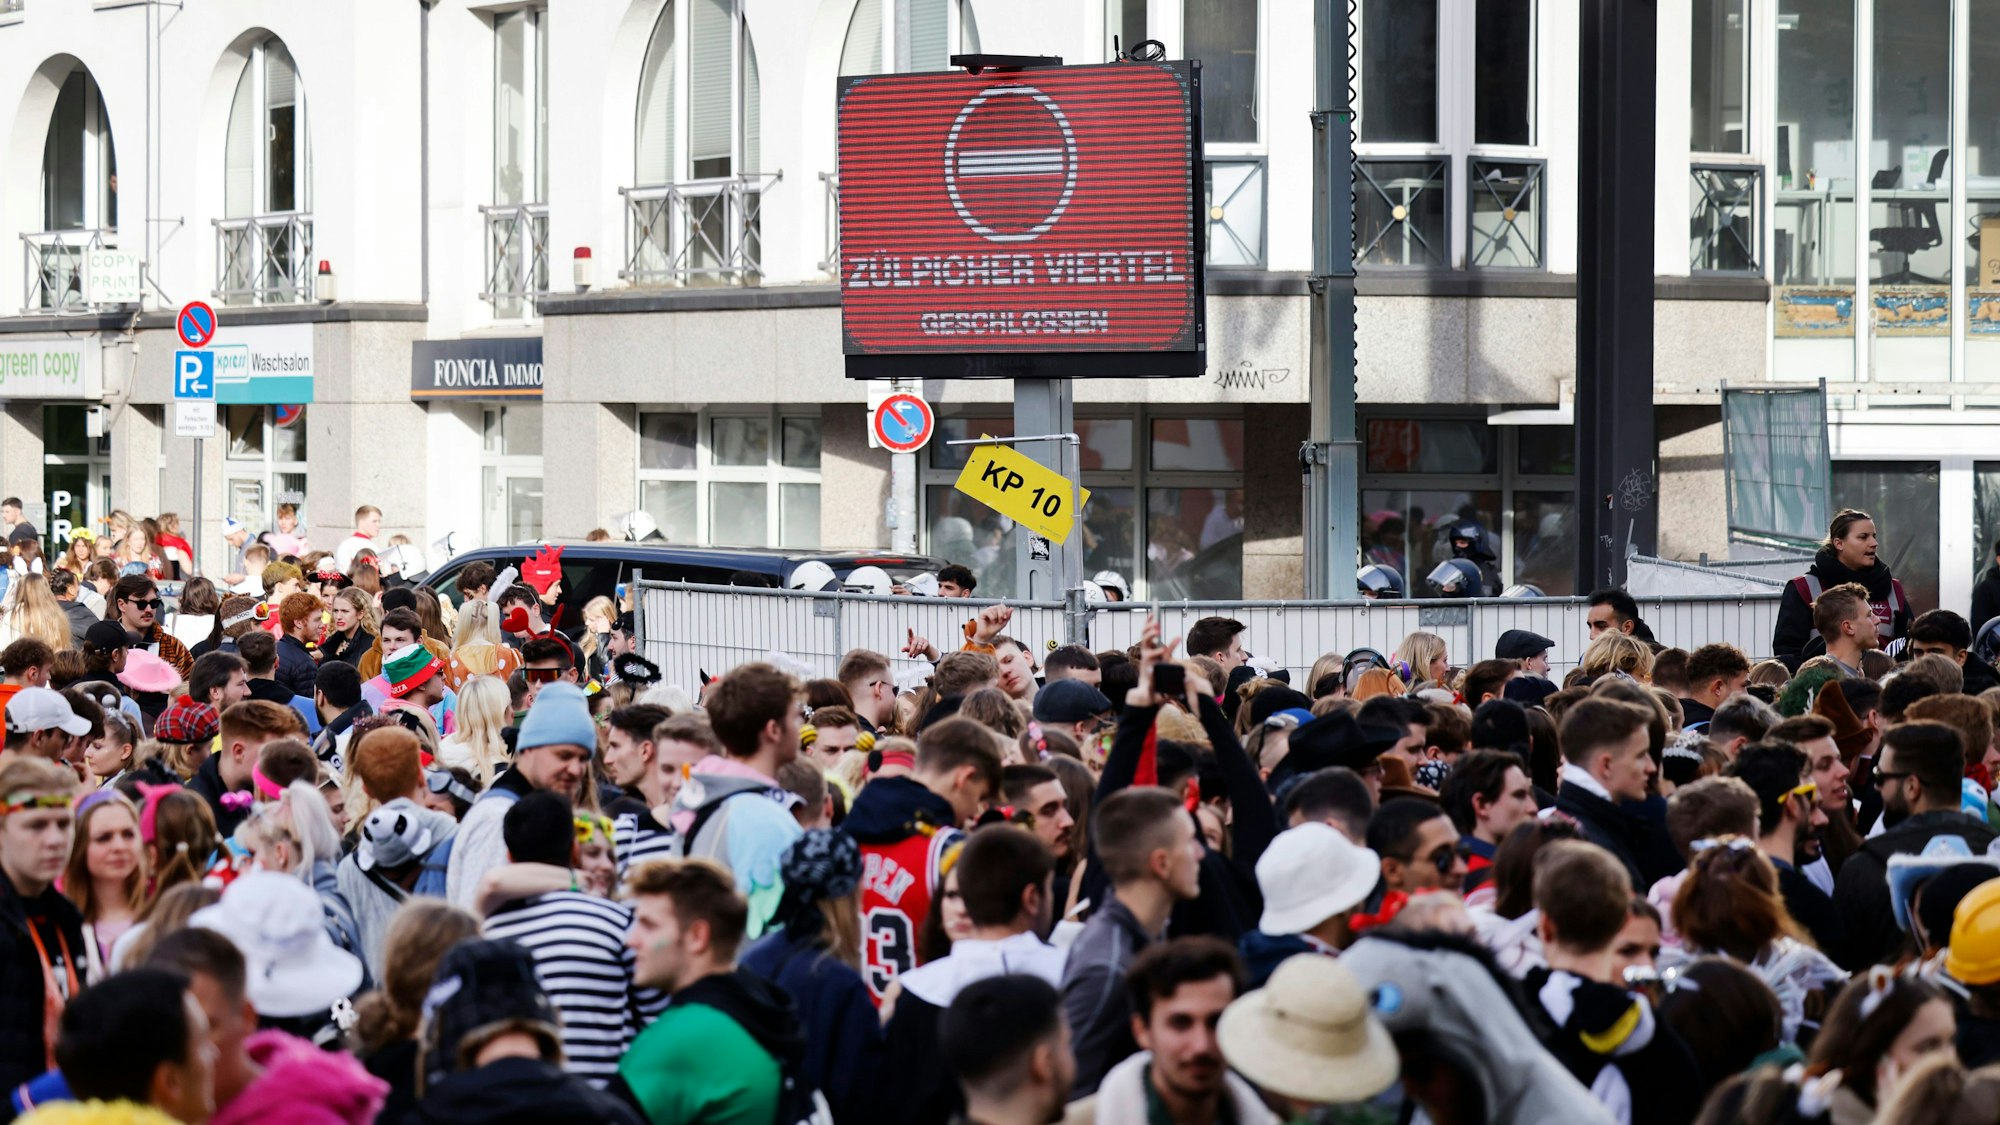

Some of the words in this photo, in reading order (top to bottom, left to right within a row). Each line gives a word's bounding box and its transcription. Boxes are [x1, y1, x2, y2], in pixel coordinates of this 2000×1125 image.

[91, 255, 136, 268] COPY
[848, 249, 1035, 287] ZÜLPICHER
[1043, 250, 1185, 283] VIERTEL
[92, 275, 137, 289] PRINT
[921, 310, 1108, 335] GESCHLOSSEN
[43, 351, 81, 384] copy
[180, 355, 203, 394] P
[251, 352, 310, 372] Waschsalon
[433, 358, 500, 387] FONCIA
[503, 363, 544, 386] IMMO
[981, 460, 1024, 493] KP
[1031, 487, 1061, 517] 10
